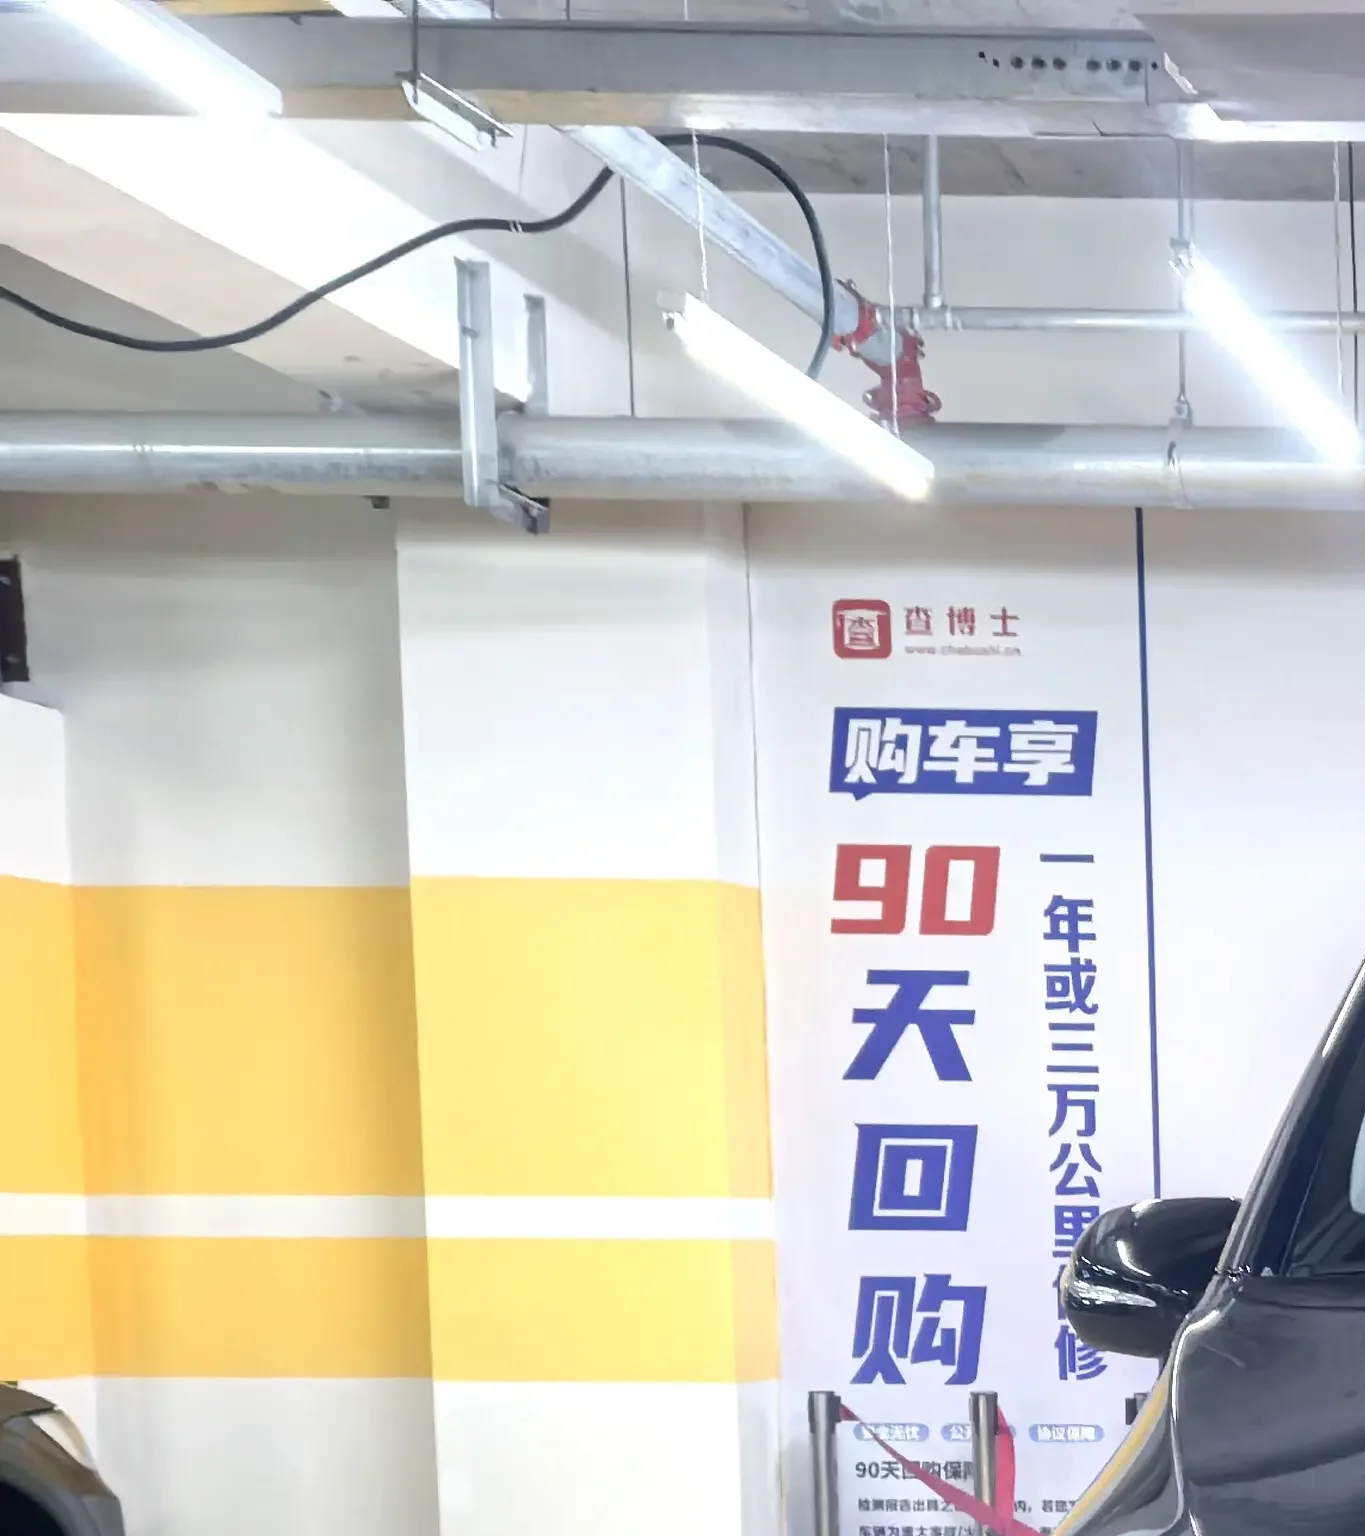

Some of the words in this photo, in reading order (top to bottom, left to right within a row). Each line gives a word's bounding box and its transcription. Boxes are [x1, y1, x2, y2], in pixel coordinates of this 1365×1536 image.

[904, 606, 1020, 637] 查博士
[843, 717, 1079, 786] 购车享
[1040, 853, 1108, 1381] 一年或三万公里修
